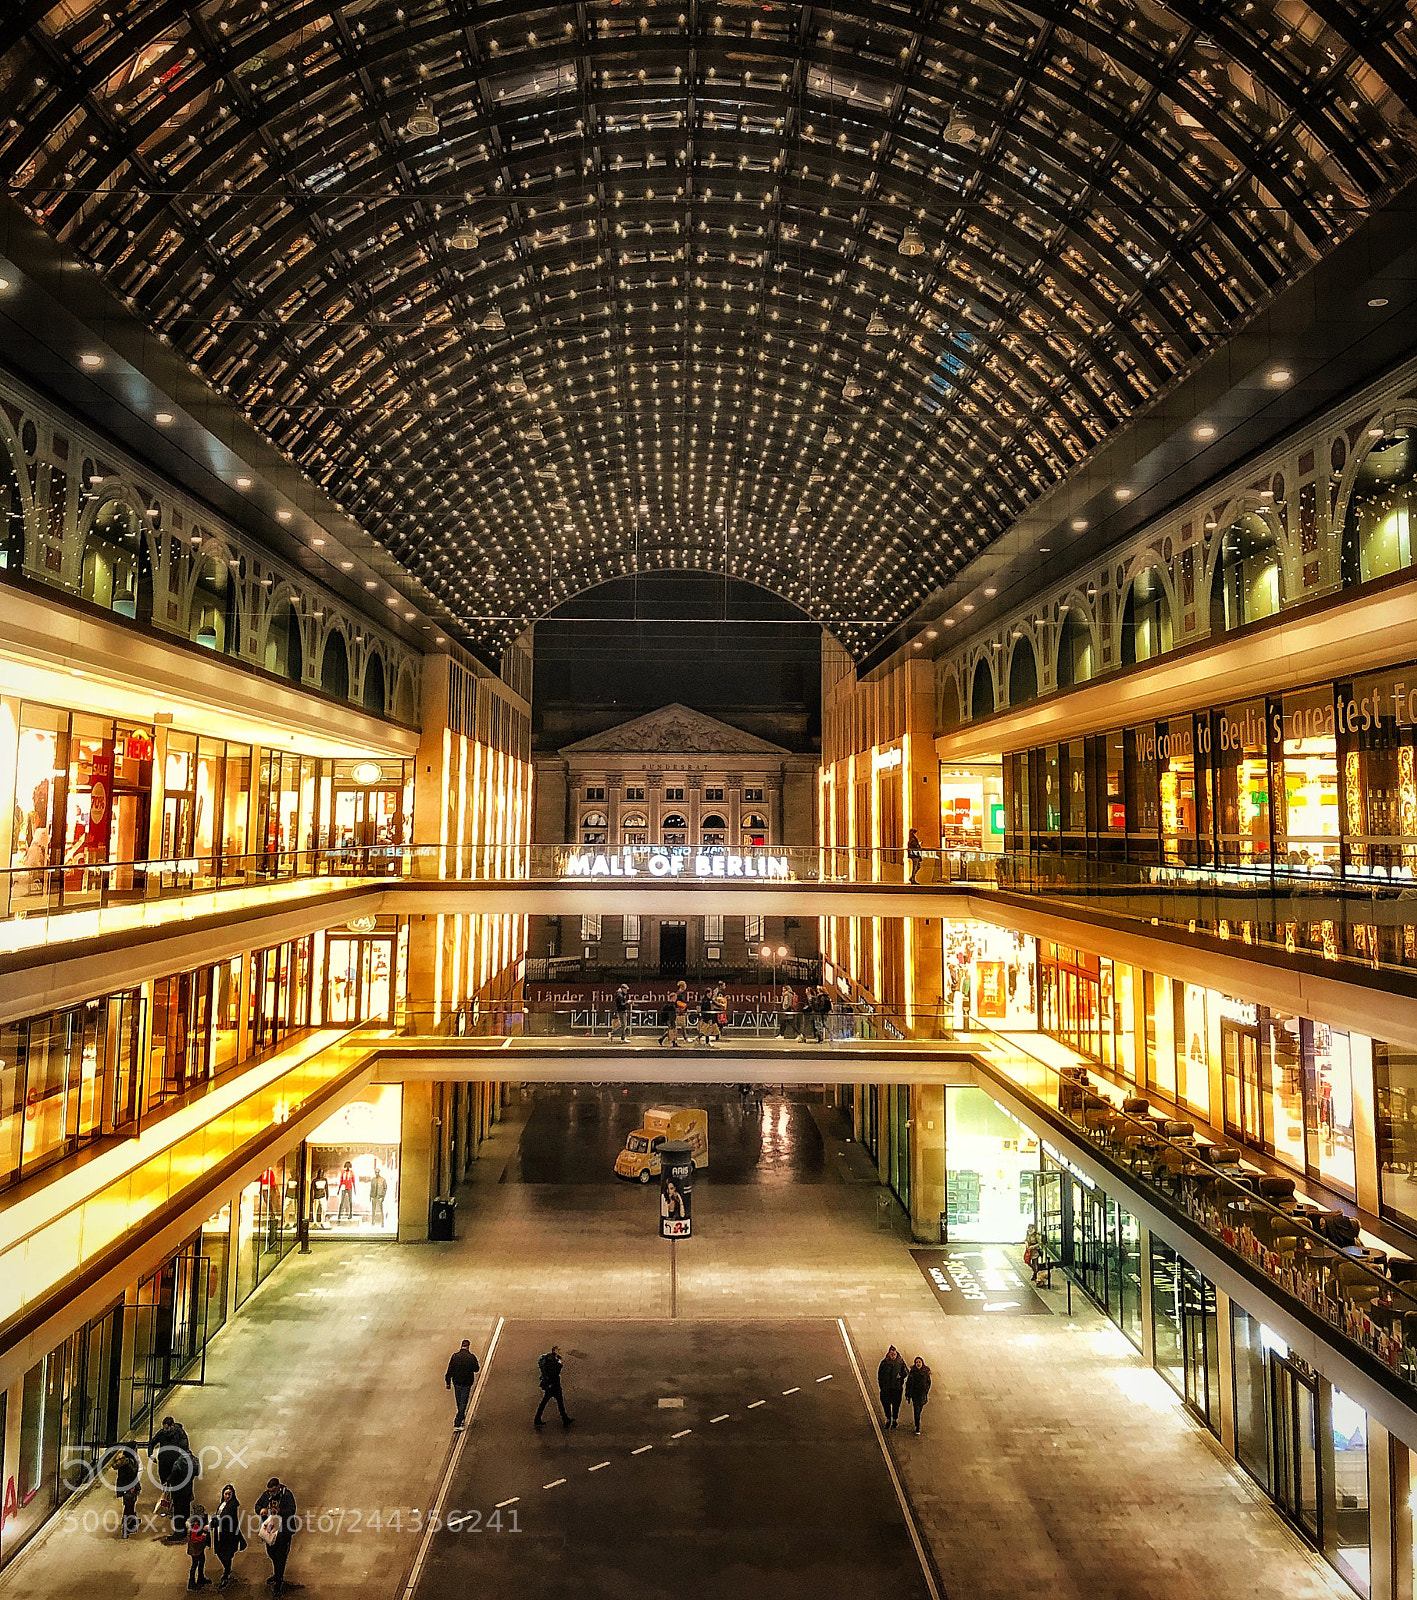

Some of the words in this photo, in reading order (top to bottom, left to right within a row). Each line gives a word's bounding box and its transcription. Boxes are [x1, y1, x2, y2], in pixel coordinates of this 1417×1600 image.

[1135, 730, 1191, 762] Welcome
[1197, 722, 1212, 754] to
[1219, 704, 1282, 751] Berlin's
[1291, 687, 1382, 750] greatest
[127, 737, 153, 760] RENO
[92, 763, 108, 776] SALE
[566, 855, 638, 877] MALL
[649, 855, 685, 877] OF
[695, 855, 789, 878] BERLIN
